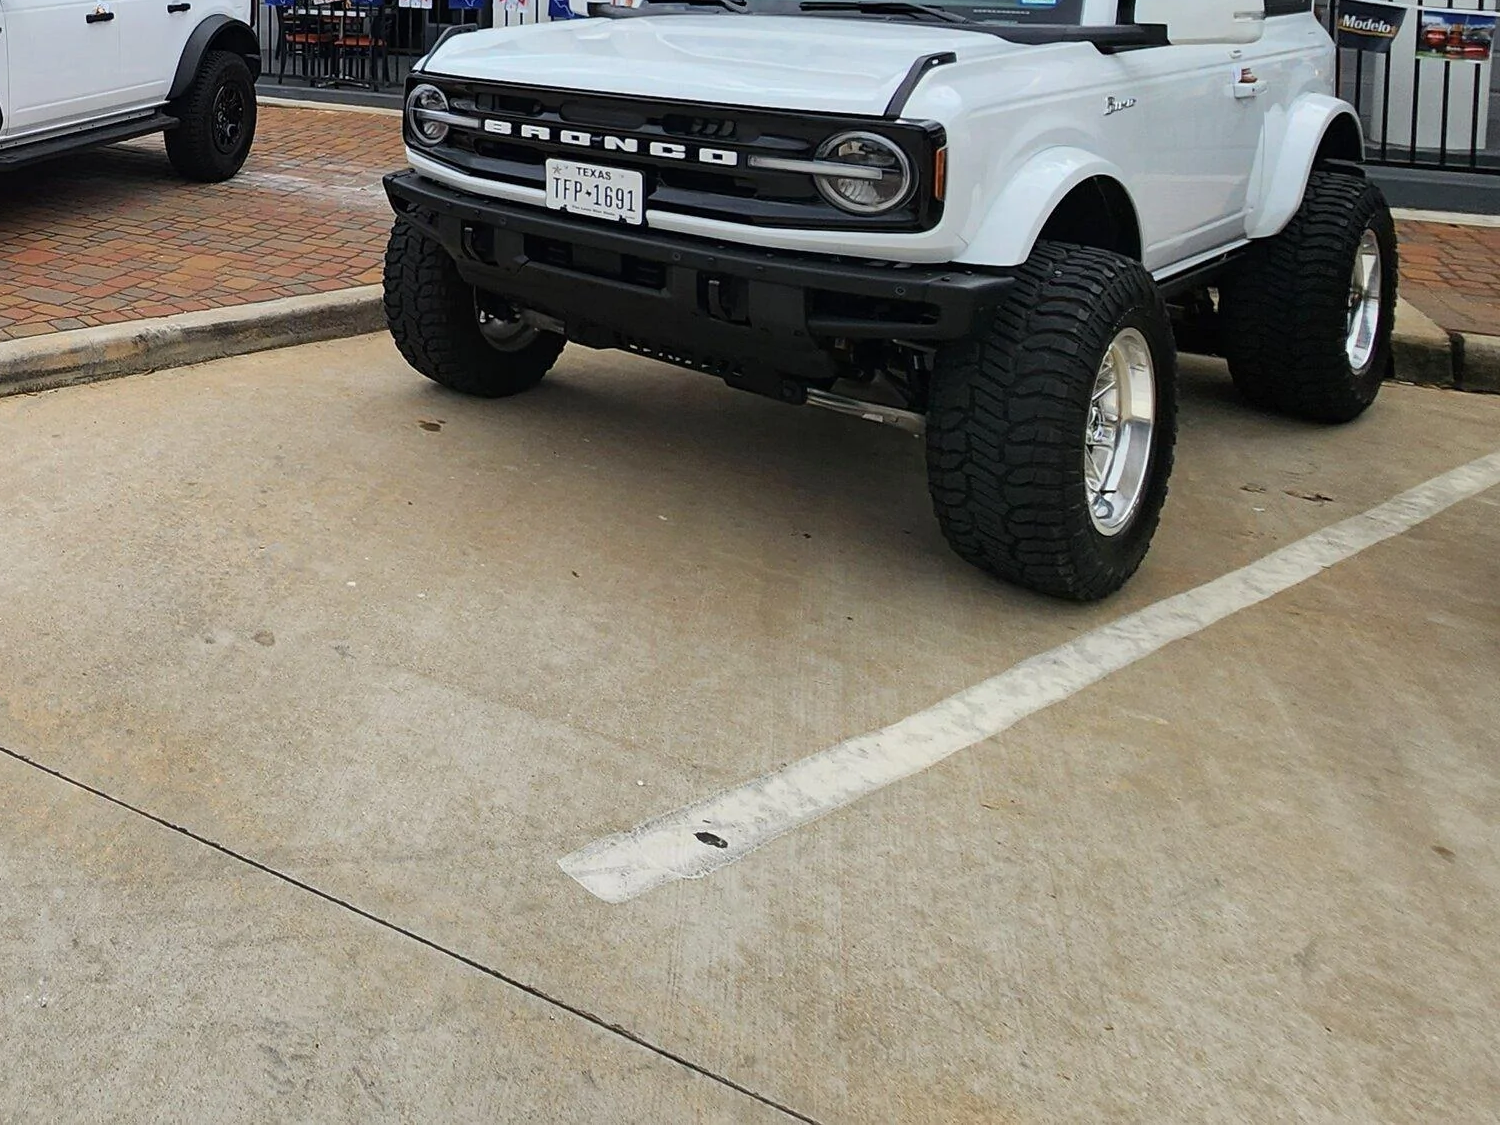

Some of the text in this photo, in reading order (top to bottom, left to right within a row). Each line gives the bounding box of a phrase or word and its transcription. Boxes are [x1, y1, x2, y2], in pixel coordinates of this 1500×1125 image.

[1342, 14, 1391, 34] Modelo
[484, 118, 738, 167] BRONCO
[575, 166, 612, 181] TEXAS
